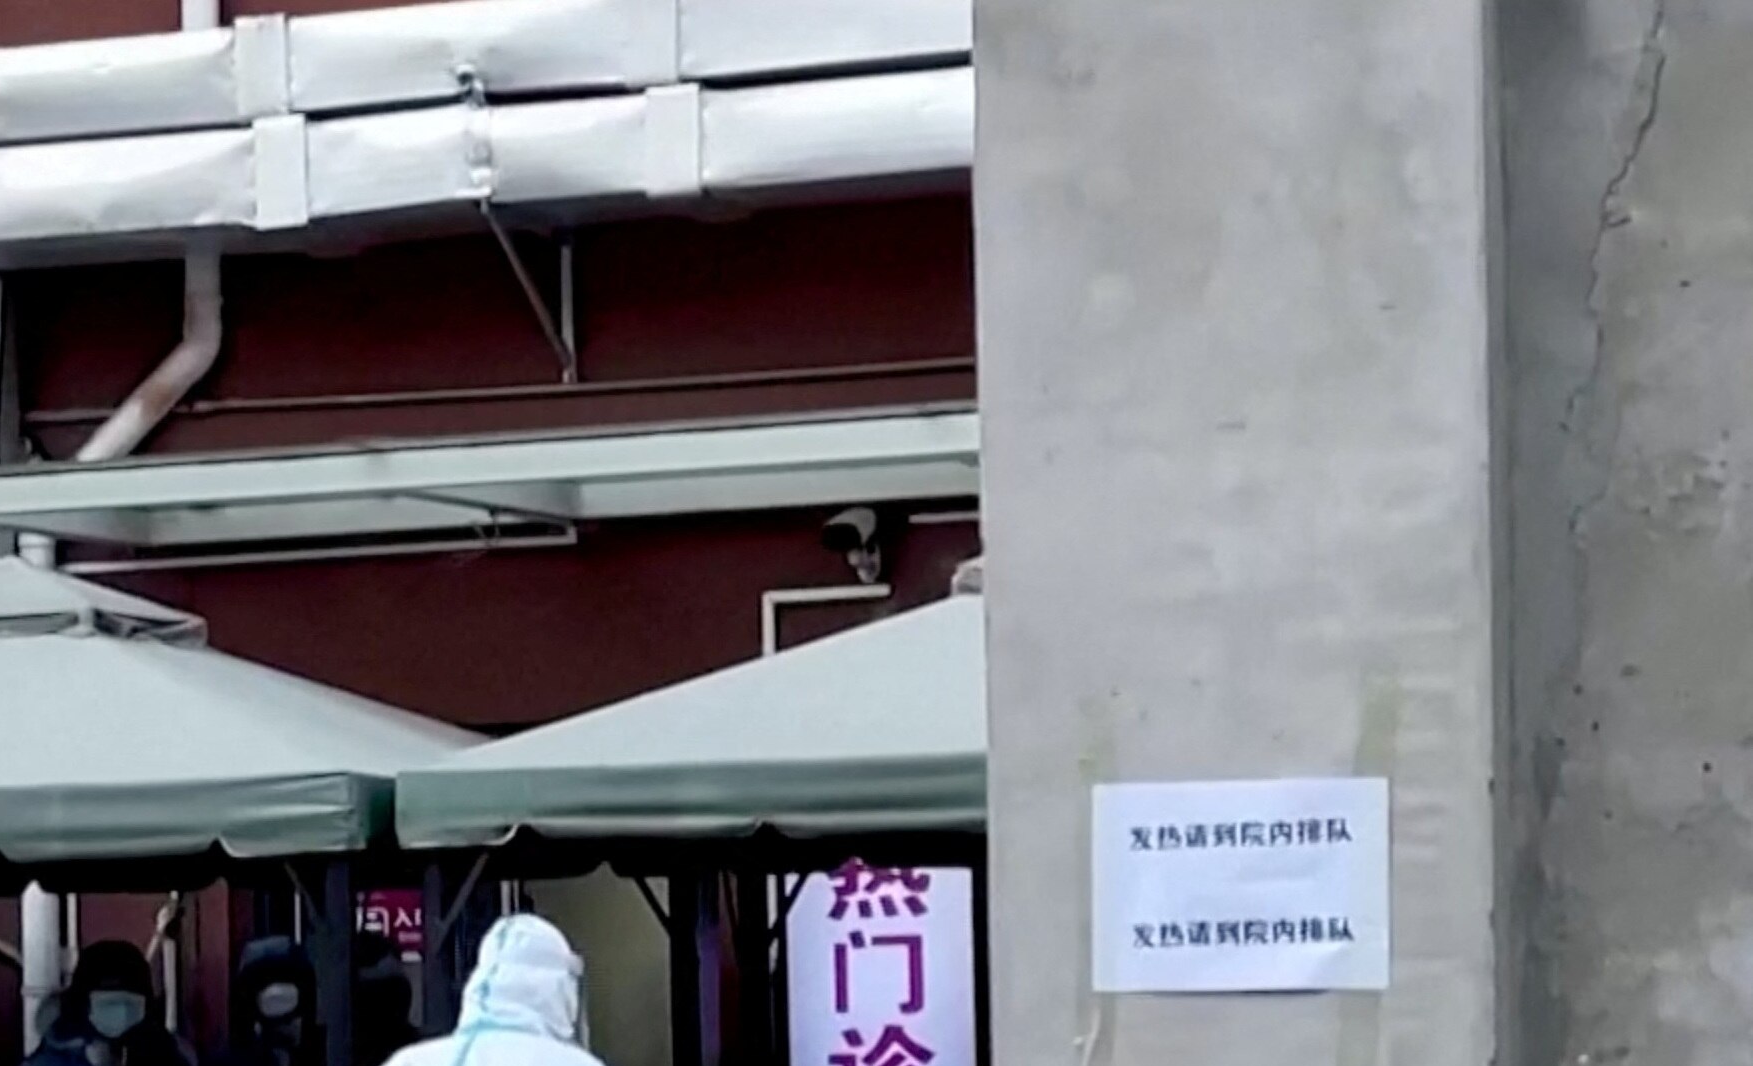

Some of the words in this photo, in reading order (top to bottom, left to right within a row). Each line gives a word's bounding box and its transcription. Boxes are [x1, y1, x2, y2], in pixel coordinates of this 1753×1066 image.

[1130, 818, 1352, 850] 发热请到院内排队
[1133, 917, 1354, 948] 发热请到院内排队
